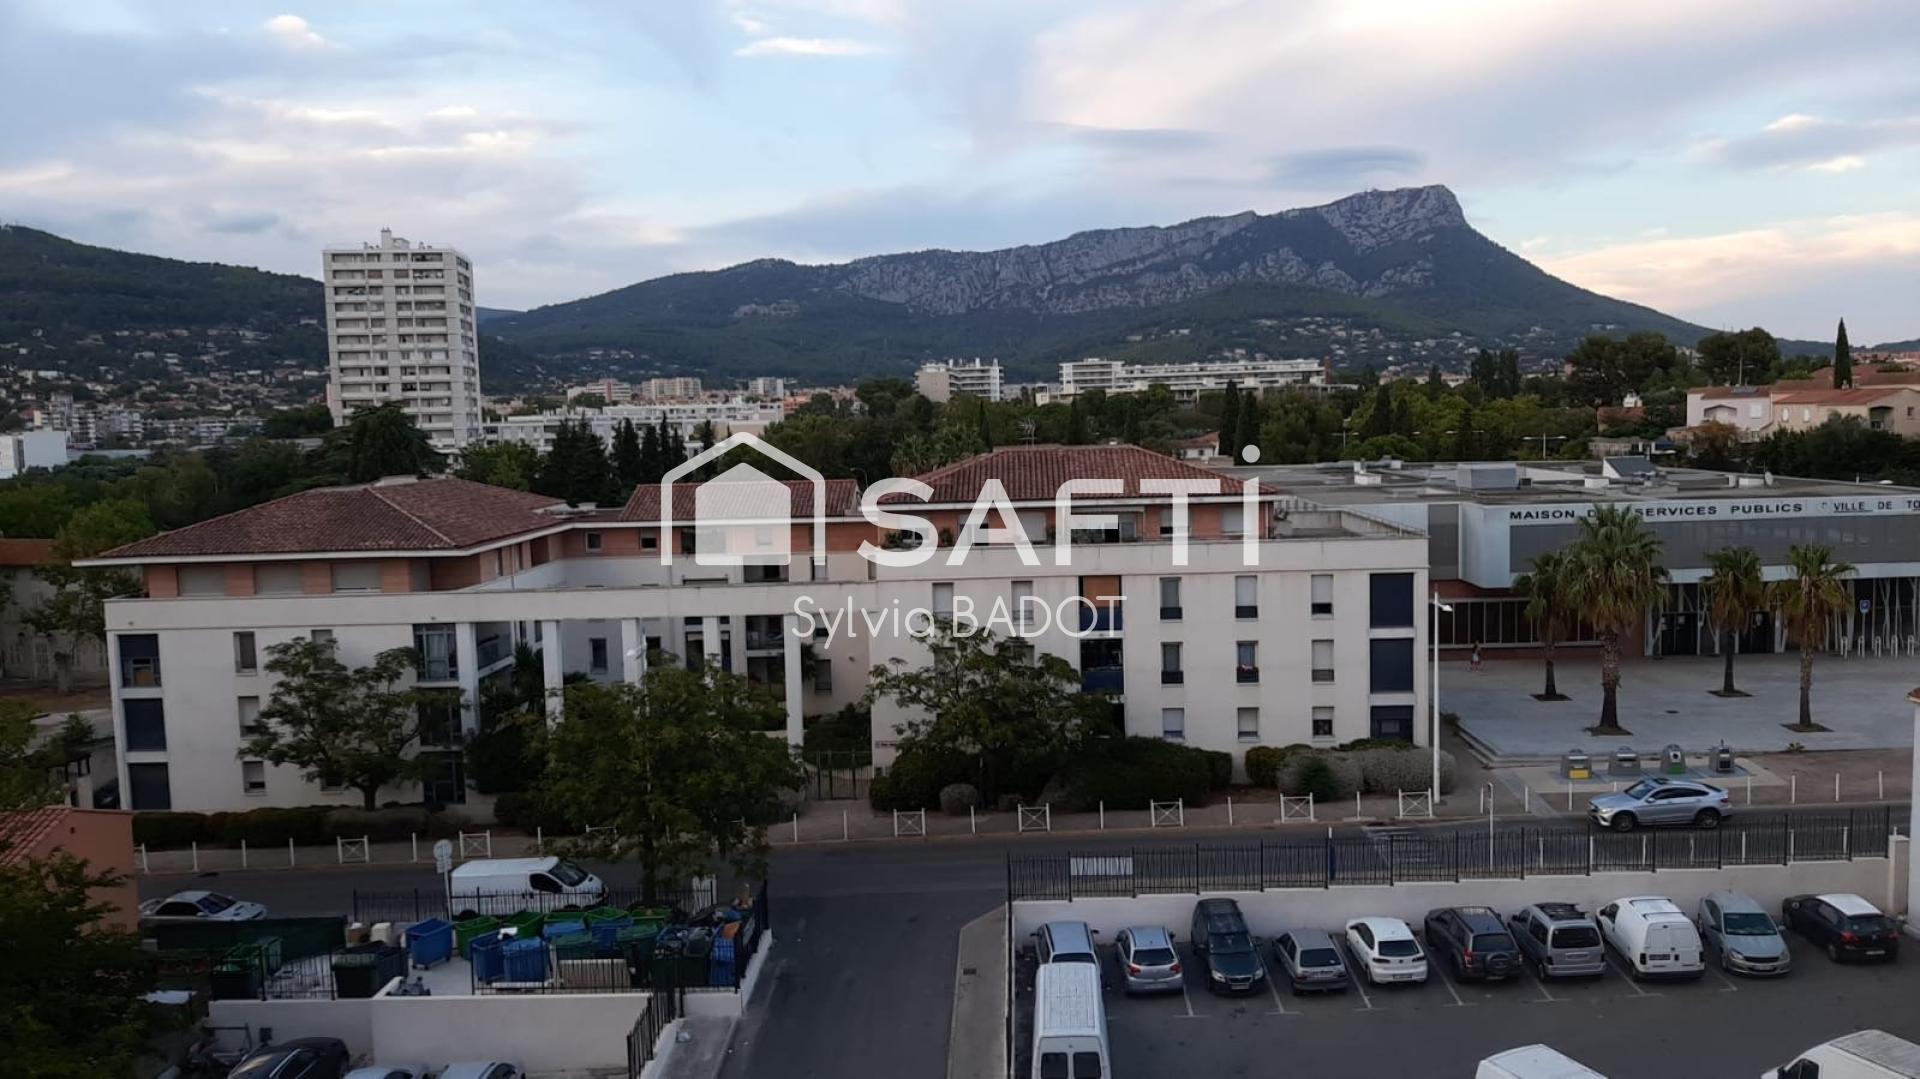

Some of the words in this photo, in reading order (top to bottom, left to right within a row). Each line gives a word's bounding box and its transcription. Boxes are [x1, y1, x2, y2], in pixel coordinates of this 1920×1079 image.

[1509, 509, 1575, 519] MAISON
[1635, 505, 1717, 517] SERVICES
[1731, 503, 1803, 515] PUBLICS
[1833, 501, 1865, 511] VILLE
[1877, 501, 1892, 510] DE
